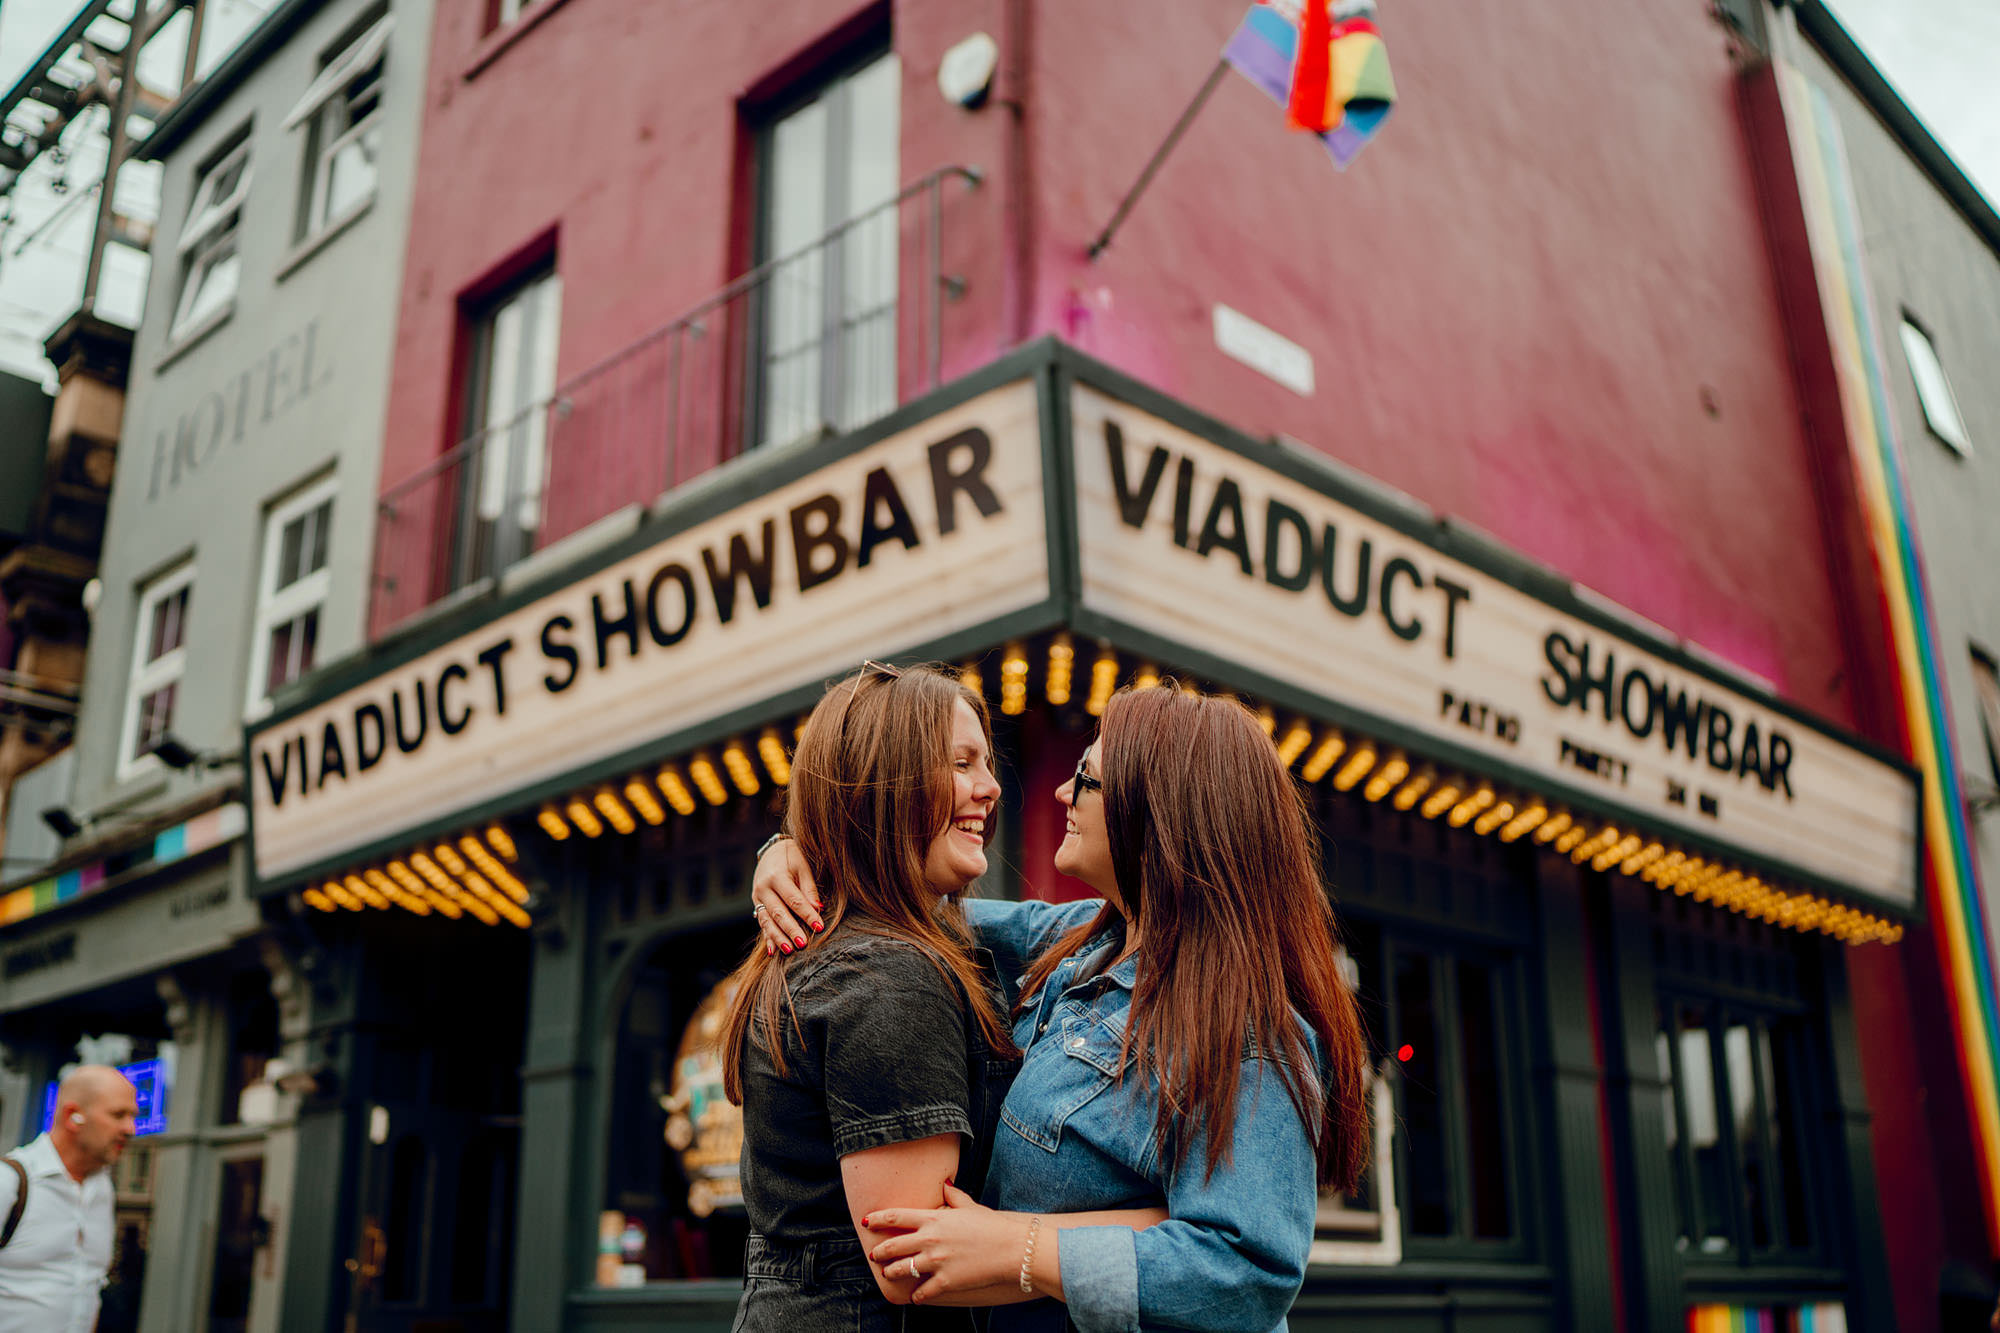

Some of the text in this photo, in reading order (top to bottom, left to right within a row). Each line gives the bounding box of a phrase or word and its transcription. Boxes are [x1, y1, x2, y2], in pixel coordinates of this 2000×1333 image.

[147, 321, 334, 502] HOTEL
[262, 424, 1005, 807] VIADUCT SHOWBAR
[1103, 419, 1796, 800] VIADUCT SHOWBAR
